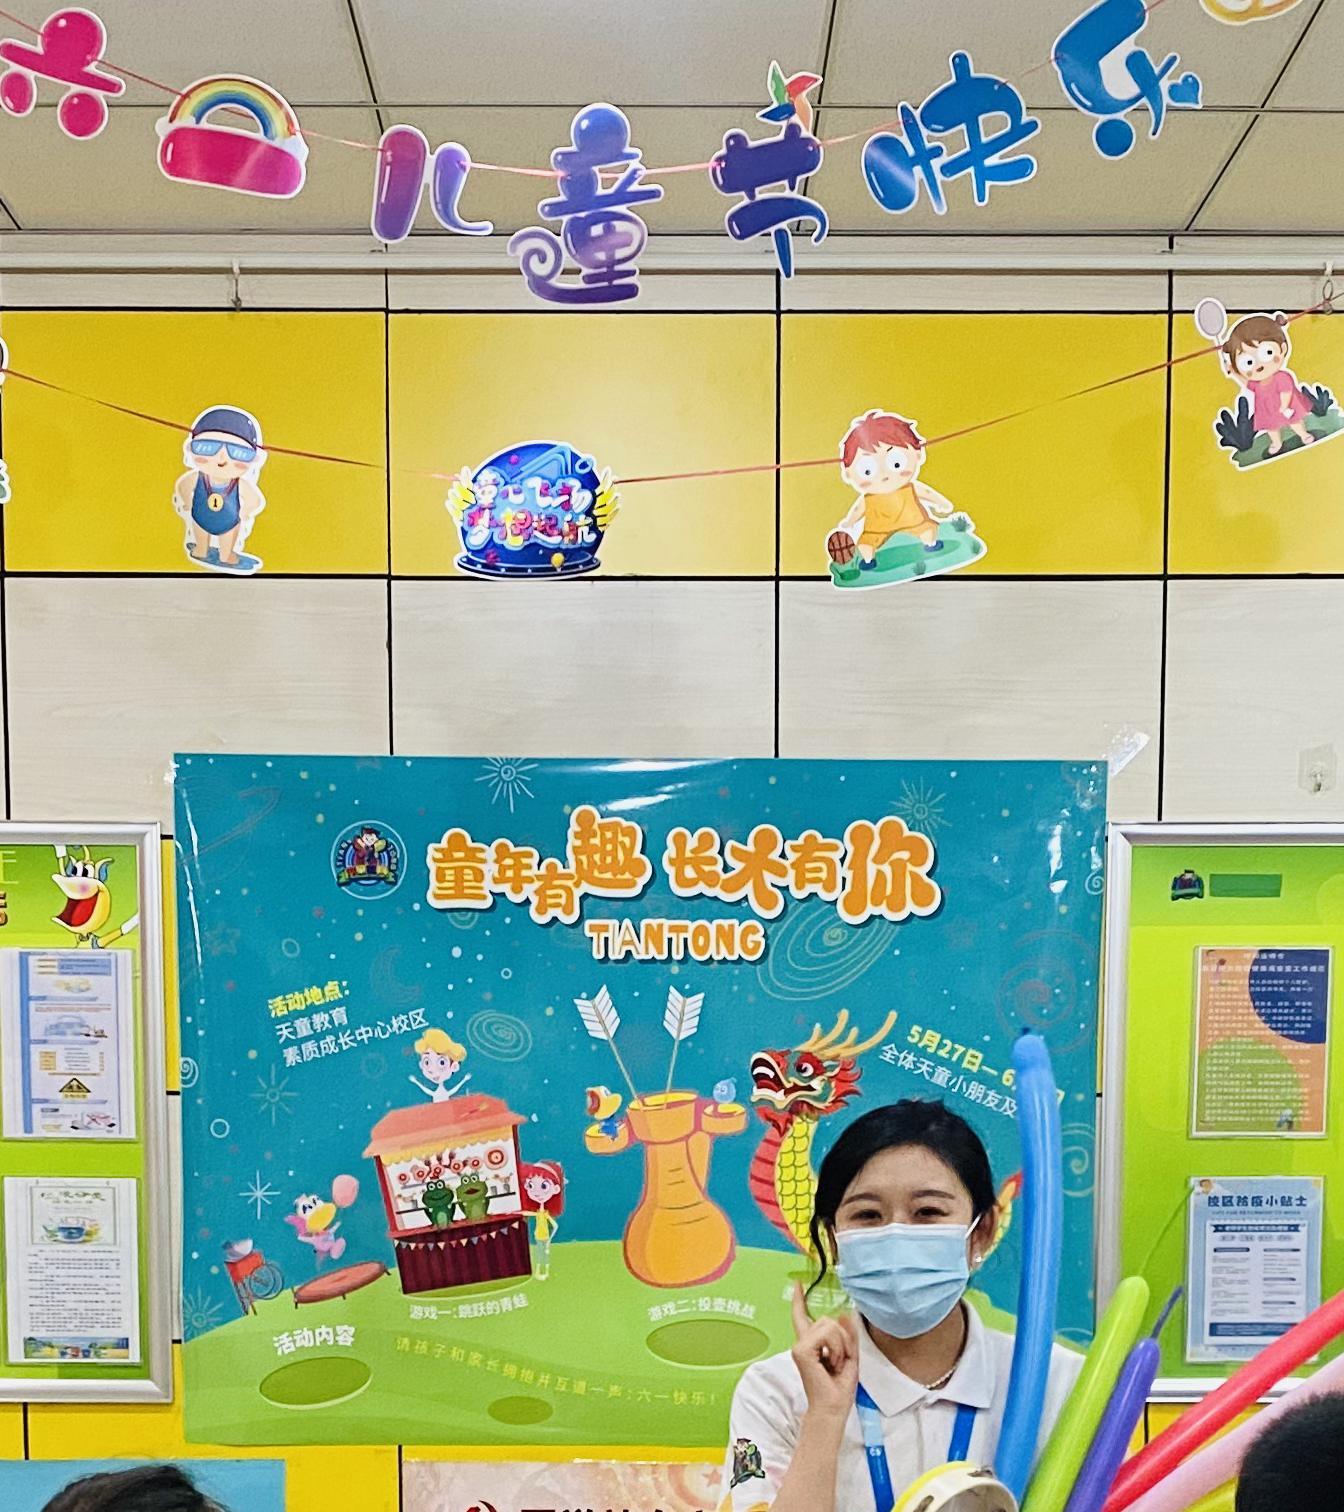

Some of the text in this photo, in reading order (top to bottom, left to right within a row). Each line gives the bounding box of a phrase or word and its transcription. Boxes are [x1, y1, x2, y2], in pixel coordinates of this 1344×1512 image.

[430, 807, 938, 919] 童年有趣 长大有你
[588, 921, 764, 961] TIANTONG
[268, 980, 350, 1018] 活动地点:
[276, 1006, 348, 1044] 天童教育
[283, 1007, 429, 1068] 素质成长中心校区
[1207, 1195, 1308, 1208] 校区防疫小贴士
[272, 1324, 356, 1356] 活动内容
